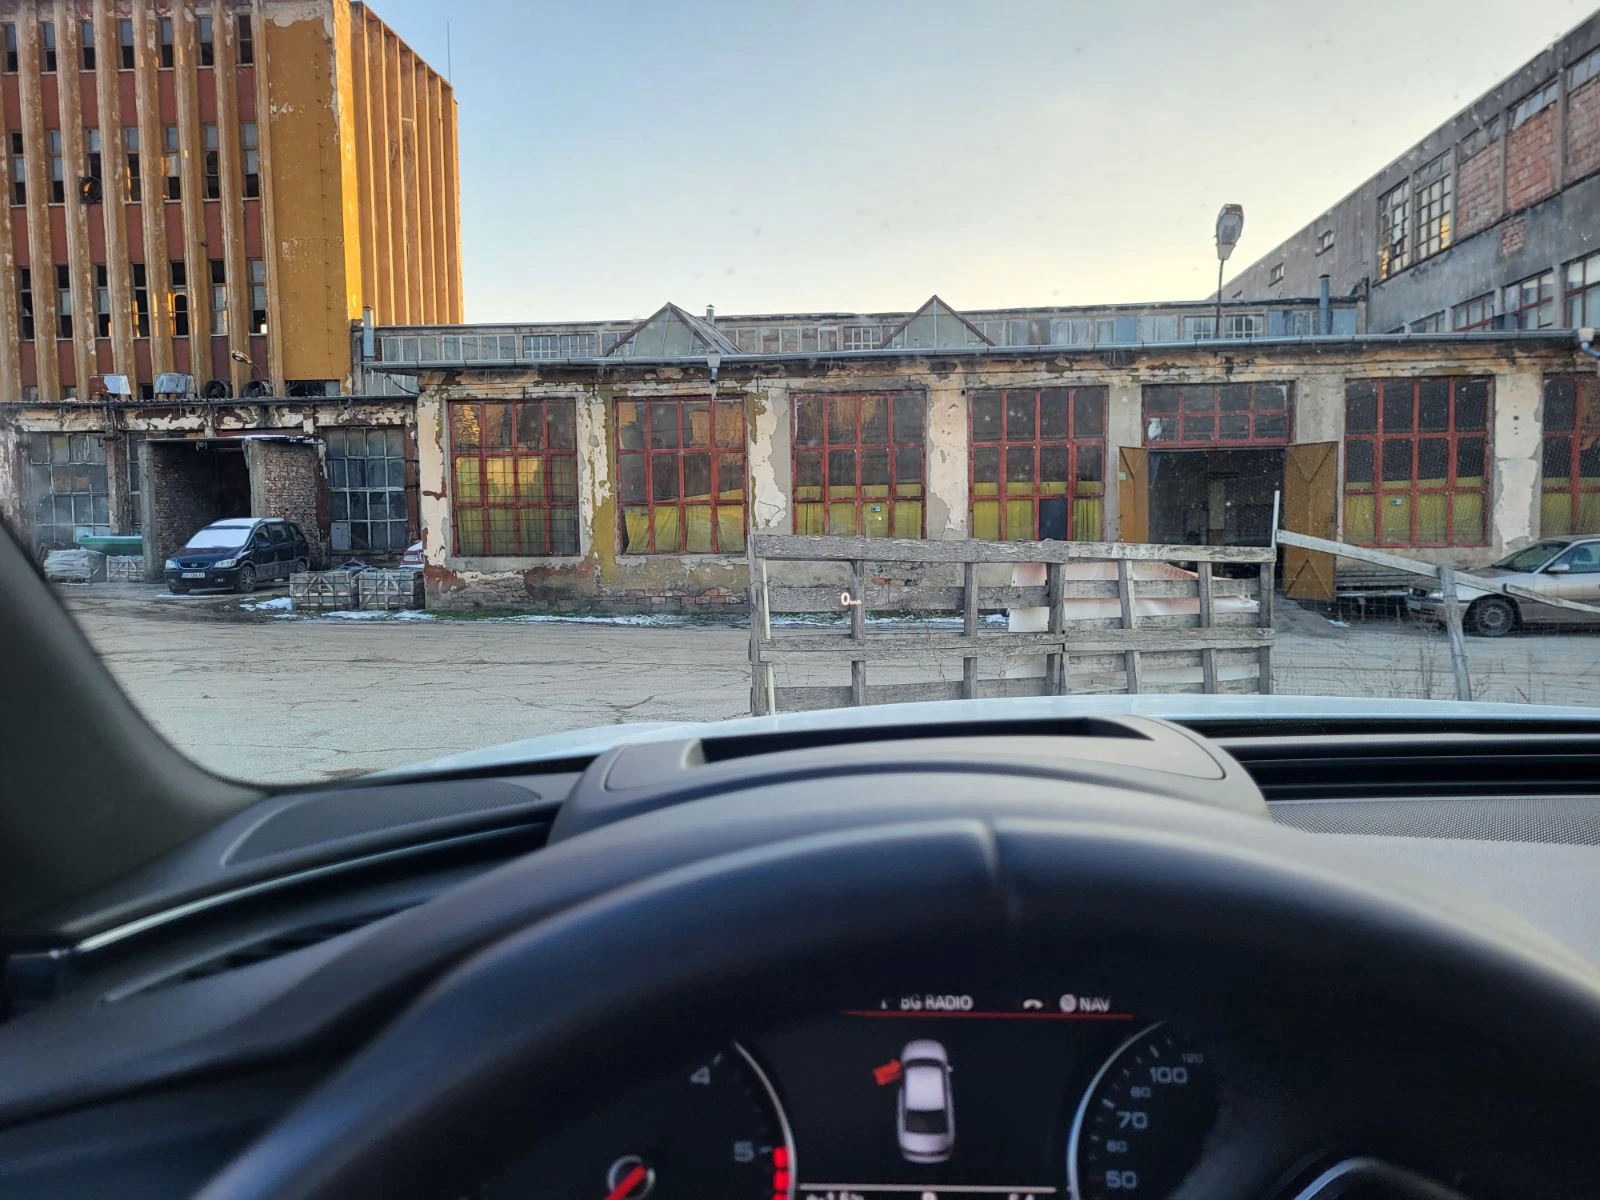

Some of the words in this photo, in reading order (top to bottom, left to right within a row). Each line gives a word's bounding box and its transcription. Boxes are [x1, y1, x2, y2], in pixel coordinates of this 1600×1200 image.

[925, 994, 974, 1011] RADIO
[1079, 997, 1110, 1012] NAV
[690, 1065, 711, 1085] 4
[1149, 1066, 1188, 1084] 100
[1116, 1111, 1148, 1129] 70
[1105, 1170, 1137, 1189] 50
